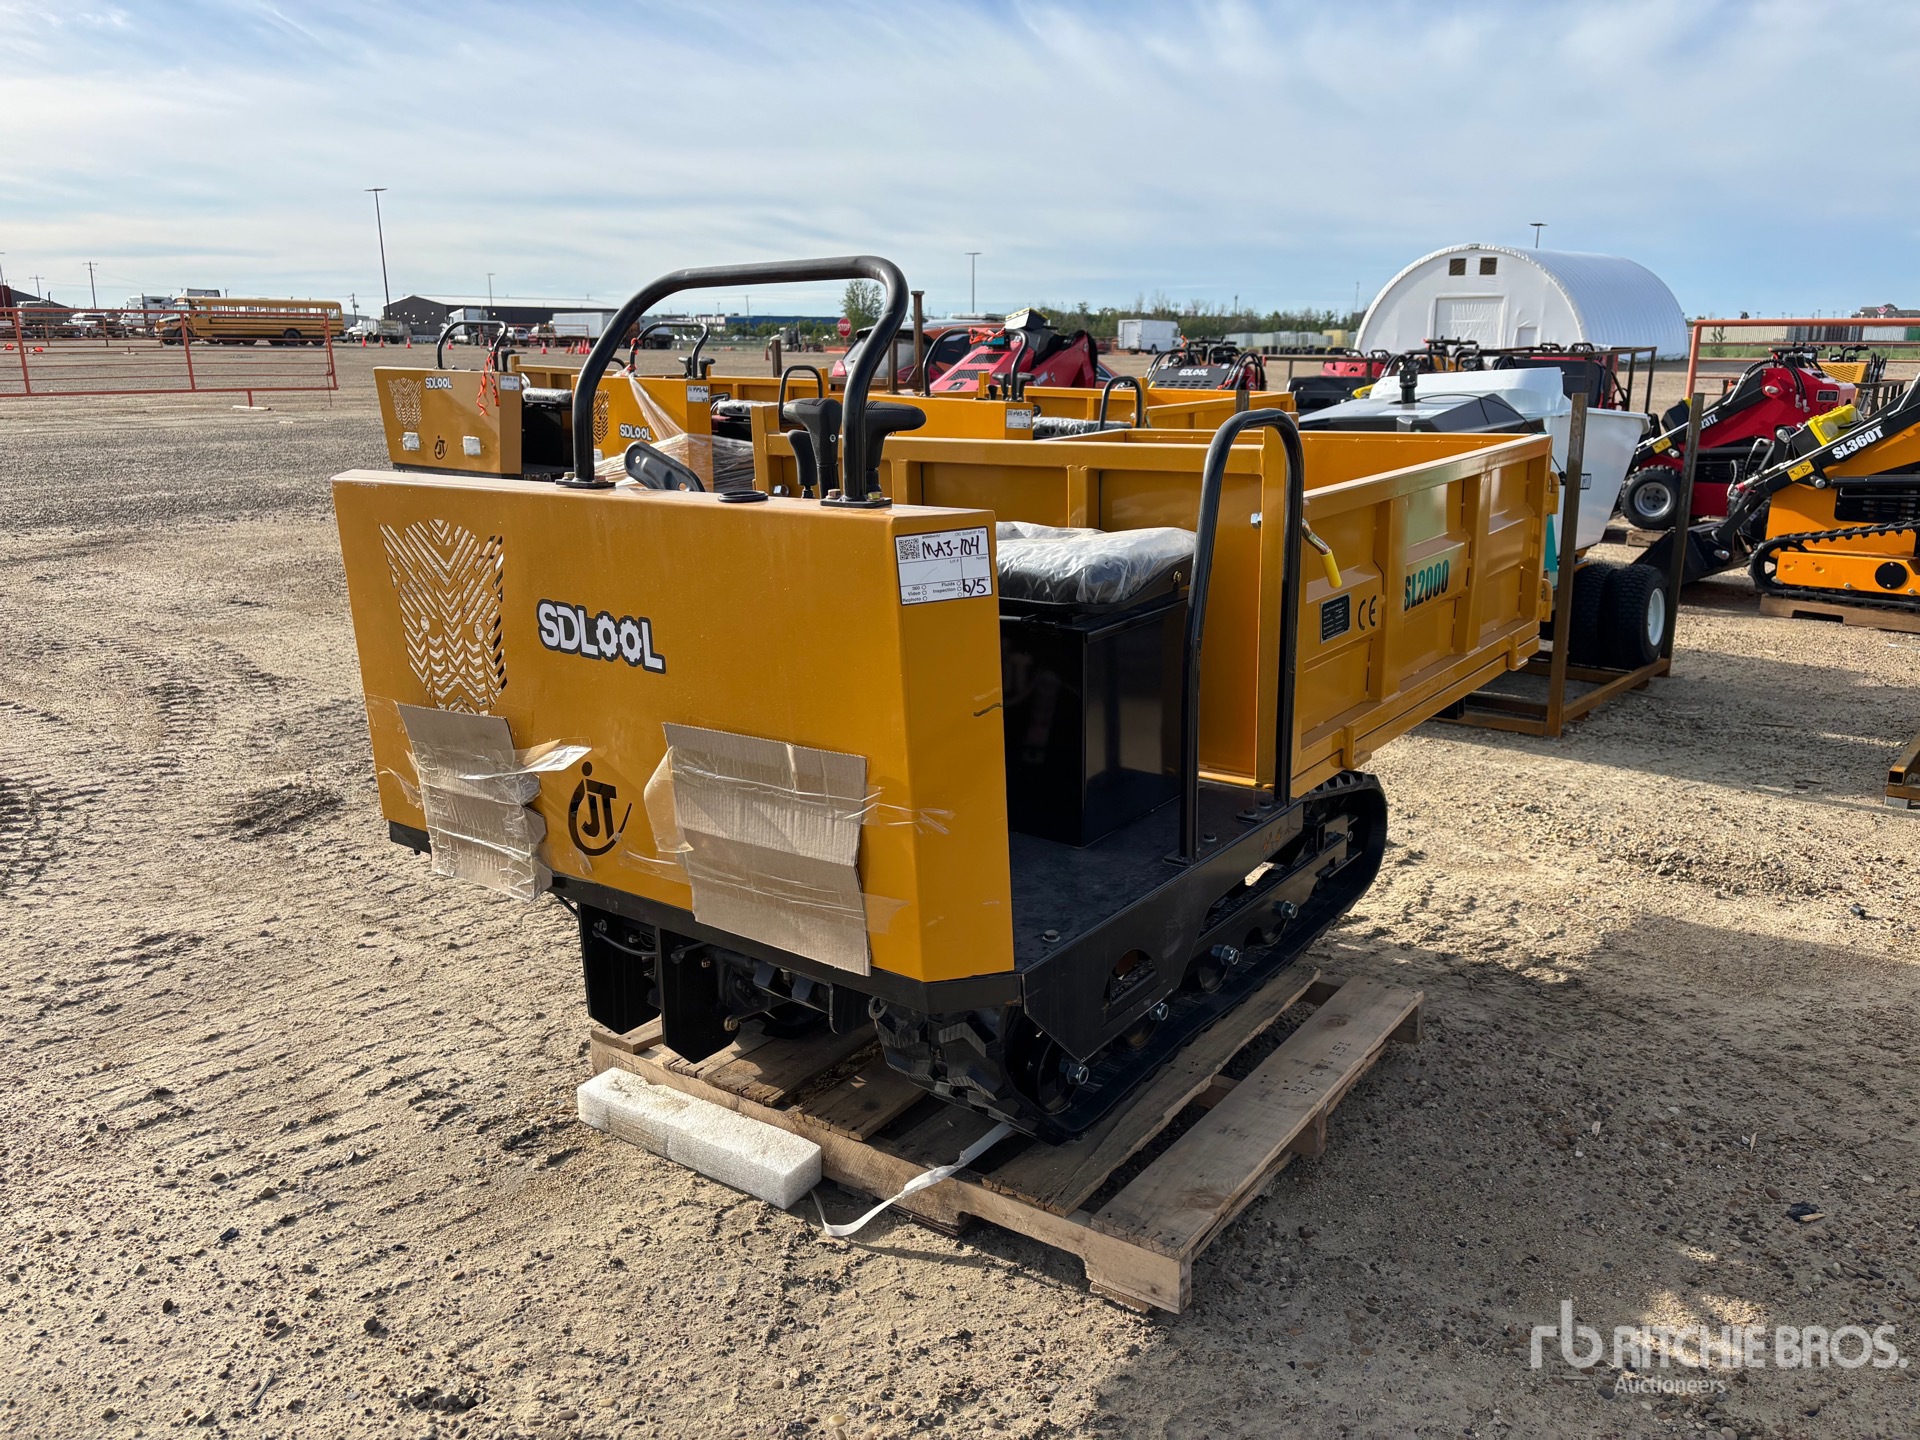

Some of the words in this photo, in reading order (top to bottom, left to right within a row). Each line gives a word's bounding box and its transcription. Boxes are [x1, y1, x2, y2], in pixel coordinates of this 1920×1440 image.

[837, 323, 851, 331] STOP
[425, 376, 453, 389] SDLOOL
[619, 423, 652, 441] SDLOOL
[1831, 425, 1884, 460] SL360T
[1404, 559, 1450, 612] SL2000
[1358, 595, 1376, 631] CE
[538, 601, 664, 672] SDLOOL
